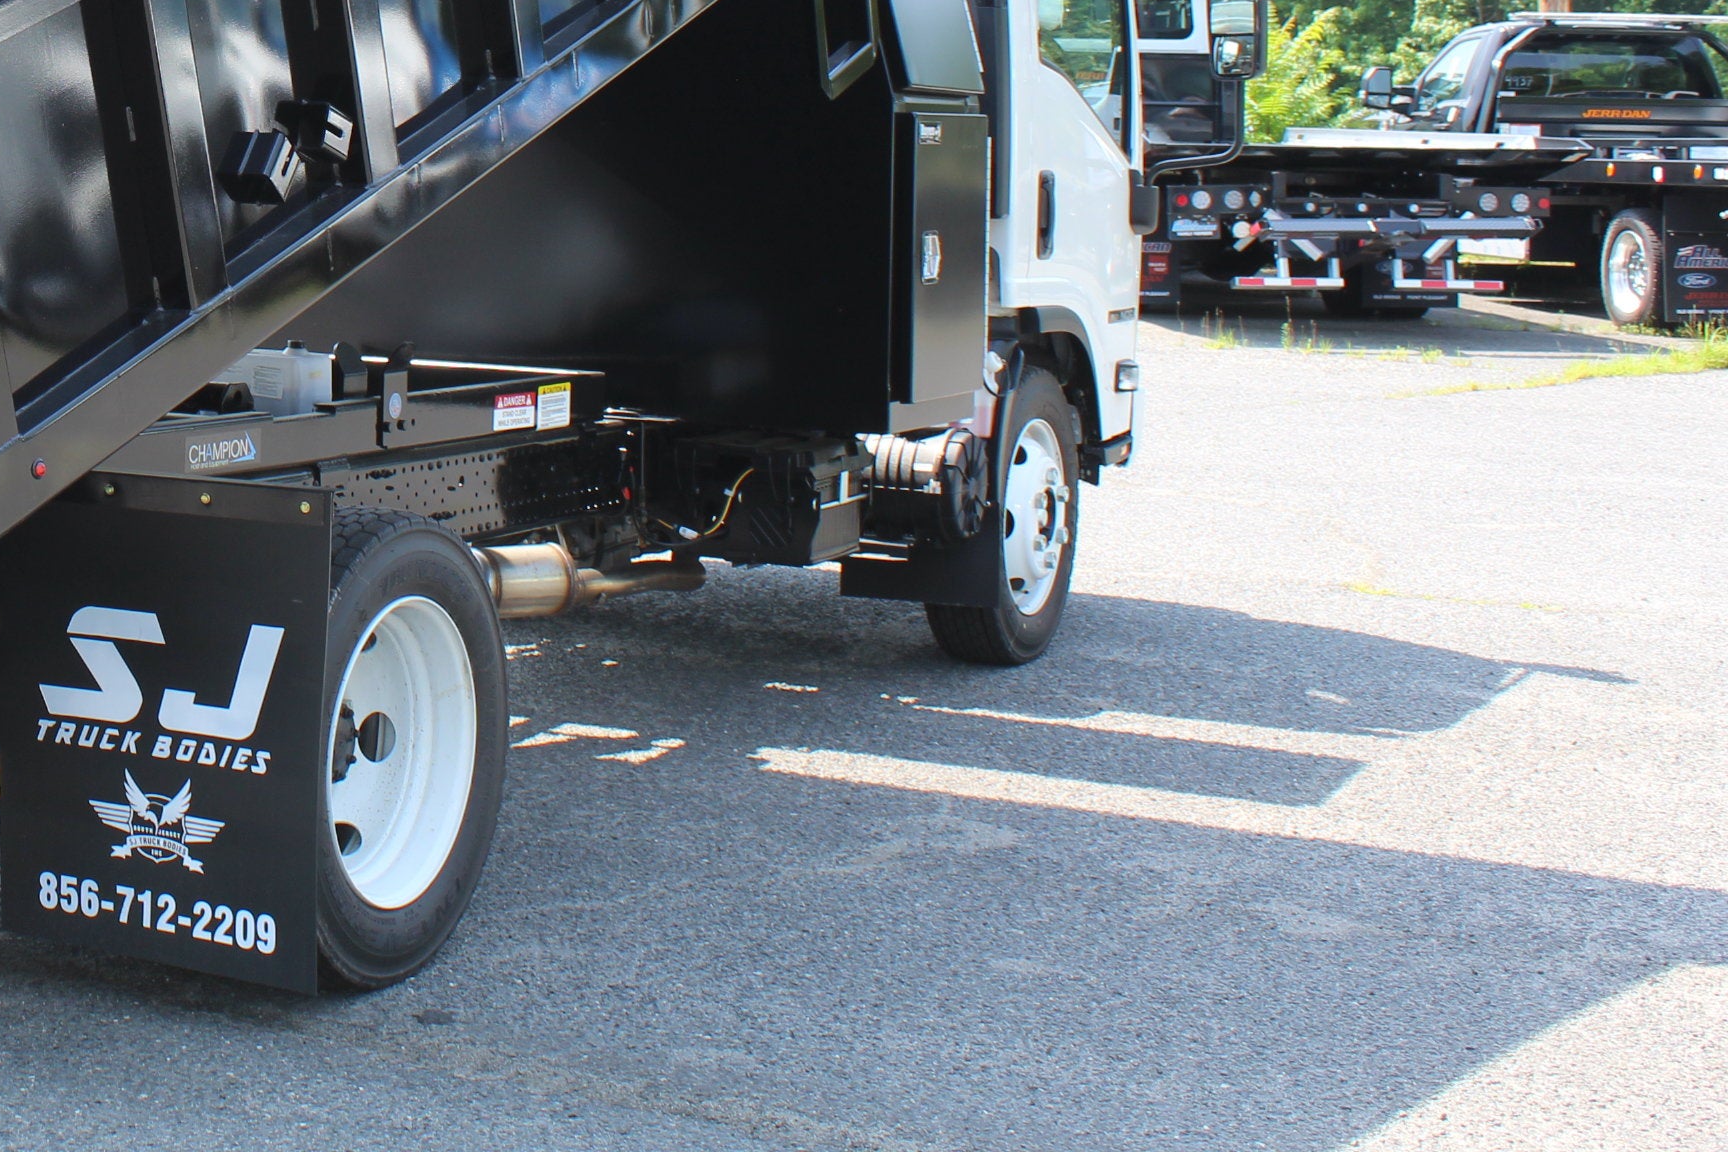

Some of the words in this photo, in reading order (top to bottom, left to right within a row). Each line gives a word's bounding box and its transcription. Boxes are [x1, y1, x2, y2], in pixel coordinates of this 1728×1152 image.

[503, 395, 526, 407] DANGER
[188, 439, 248, 463] CHAMPION
[38, 605, 285, 741] SJ
[37, 719, 142, 755] TRUCK
[151, 735, 271, 775] BODIES
[139, 836, 161, 846] TRUCK
[162, 839, 187, 856] BODIES
[39, 871, 276, 955] 856-712-2209
